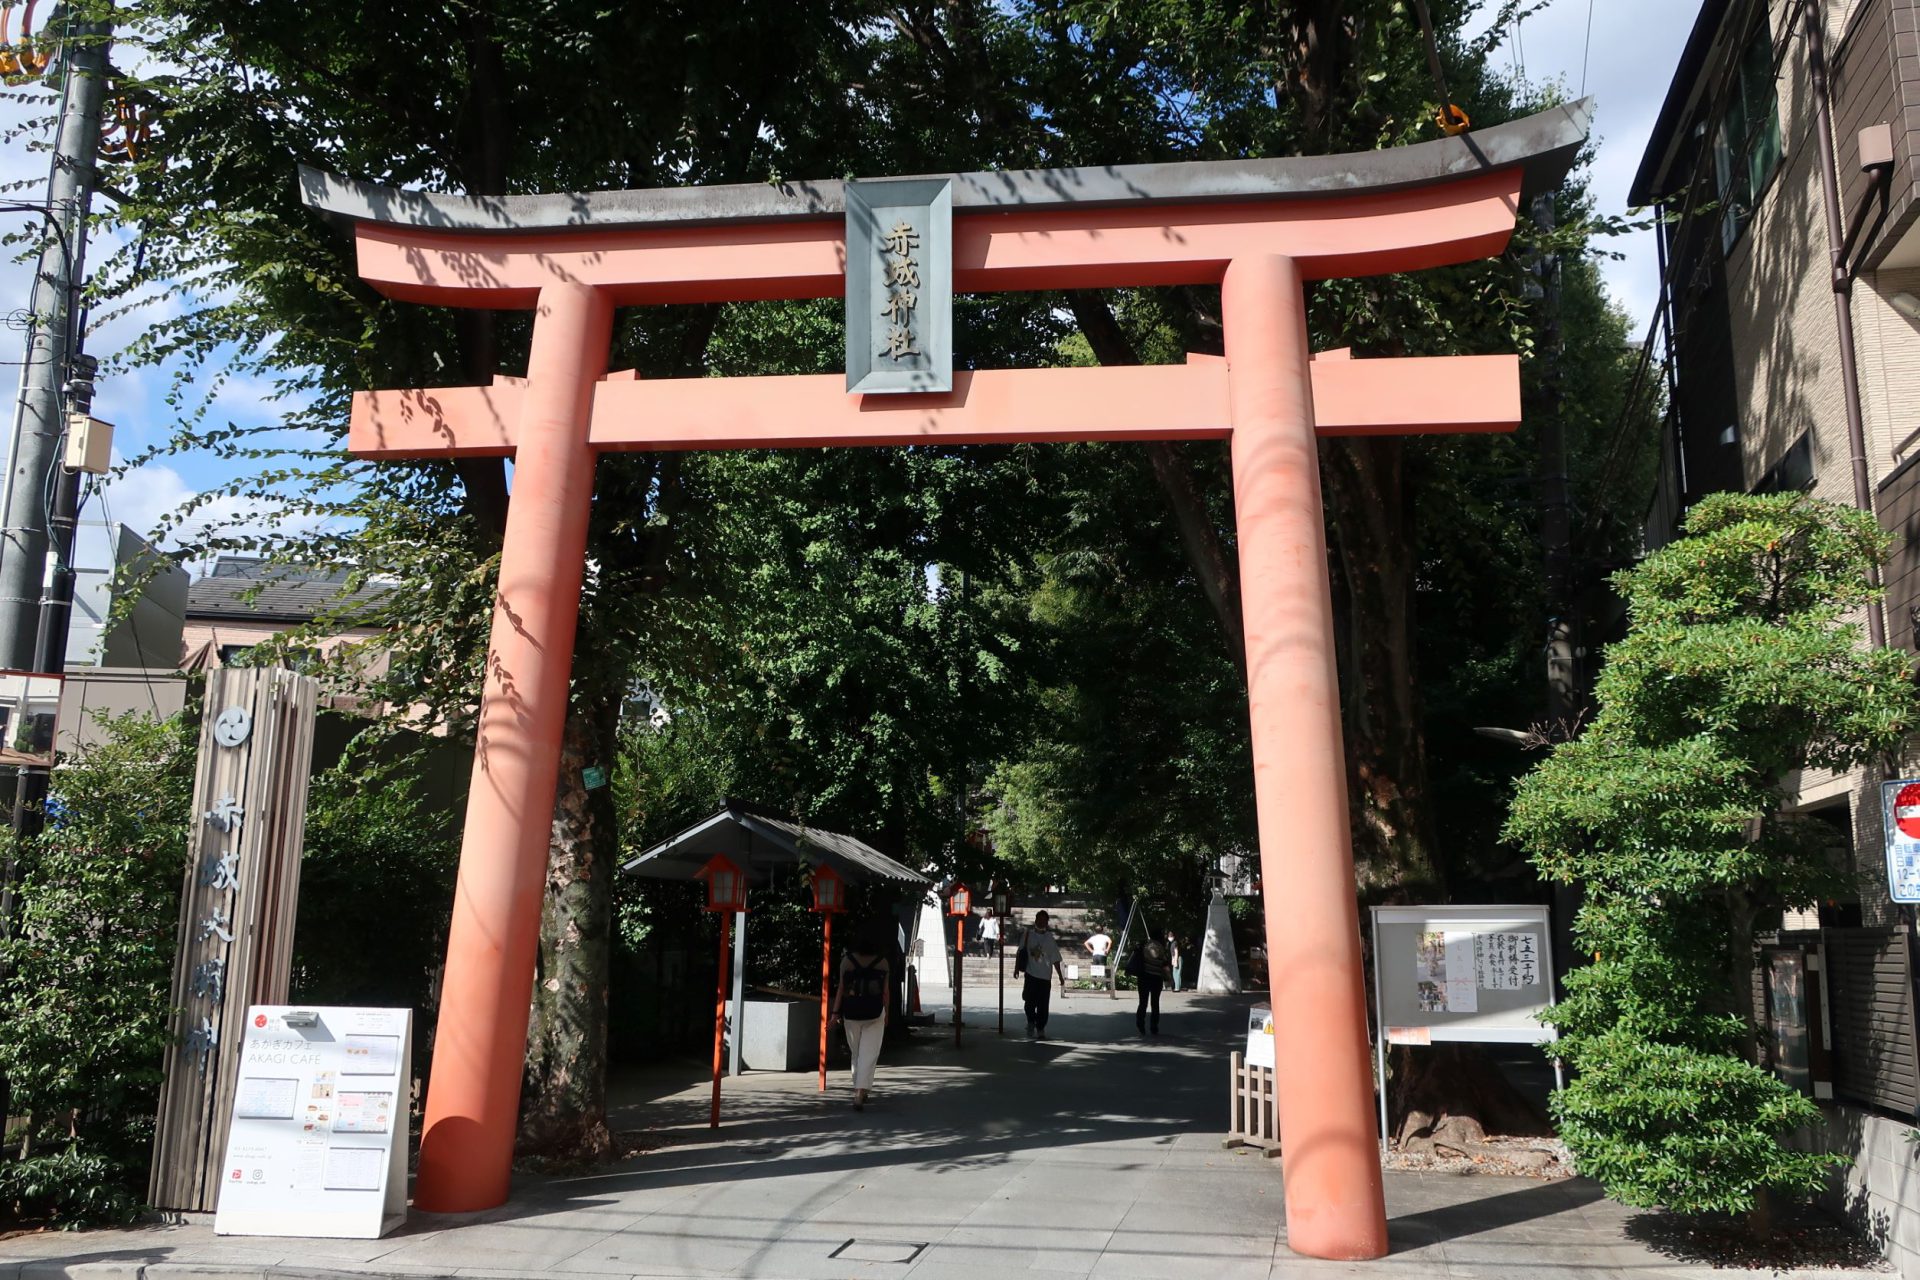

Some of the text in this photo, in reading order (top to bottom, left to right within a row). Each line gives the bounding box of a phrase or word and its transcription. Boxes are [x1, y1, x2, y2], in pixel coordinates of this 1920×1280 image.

[879, 219, 921, 361] 赤城神社
[249, 1039, 313, 1051] あかぎカフェ
[248, 1053, 286, 1064] AKAGI
